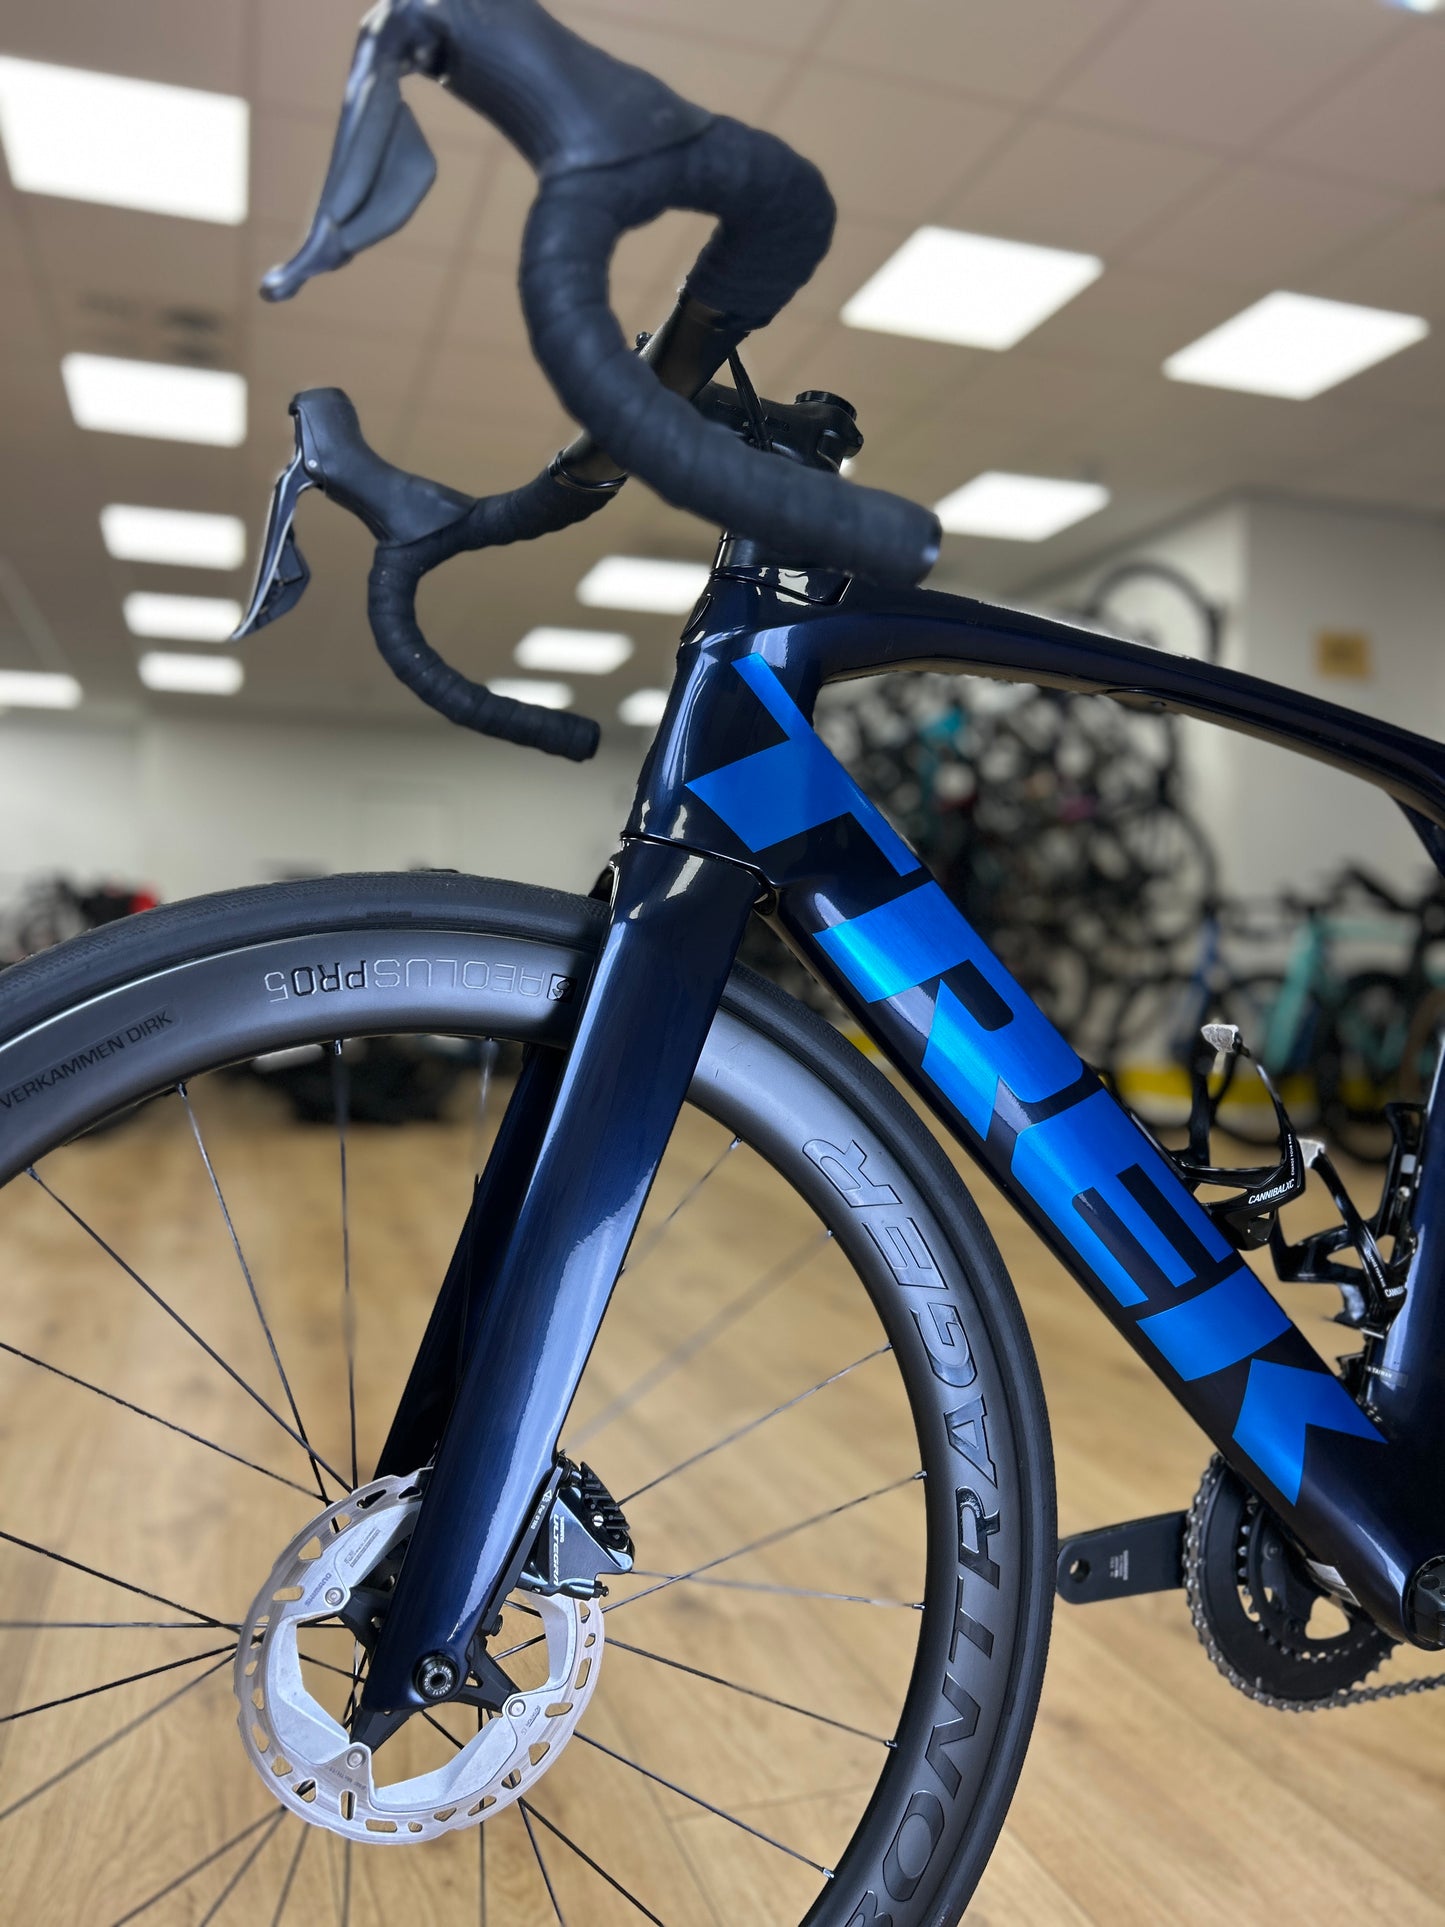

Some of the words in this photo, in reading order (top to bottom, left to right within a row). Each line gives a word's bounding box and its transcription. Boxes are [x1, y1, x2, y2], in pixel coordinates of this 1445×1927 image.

[0, 1034, 125, 1108] VERKAMMEN
[126, 1009, 174, 1053] DIRK
[685, 651, 1388, 1506] TREK
[304, 1572, 332, 1607] SHIMANO
